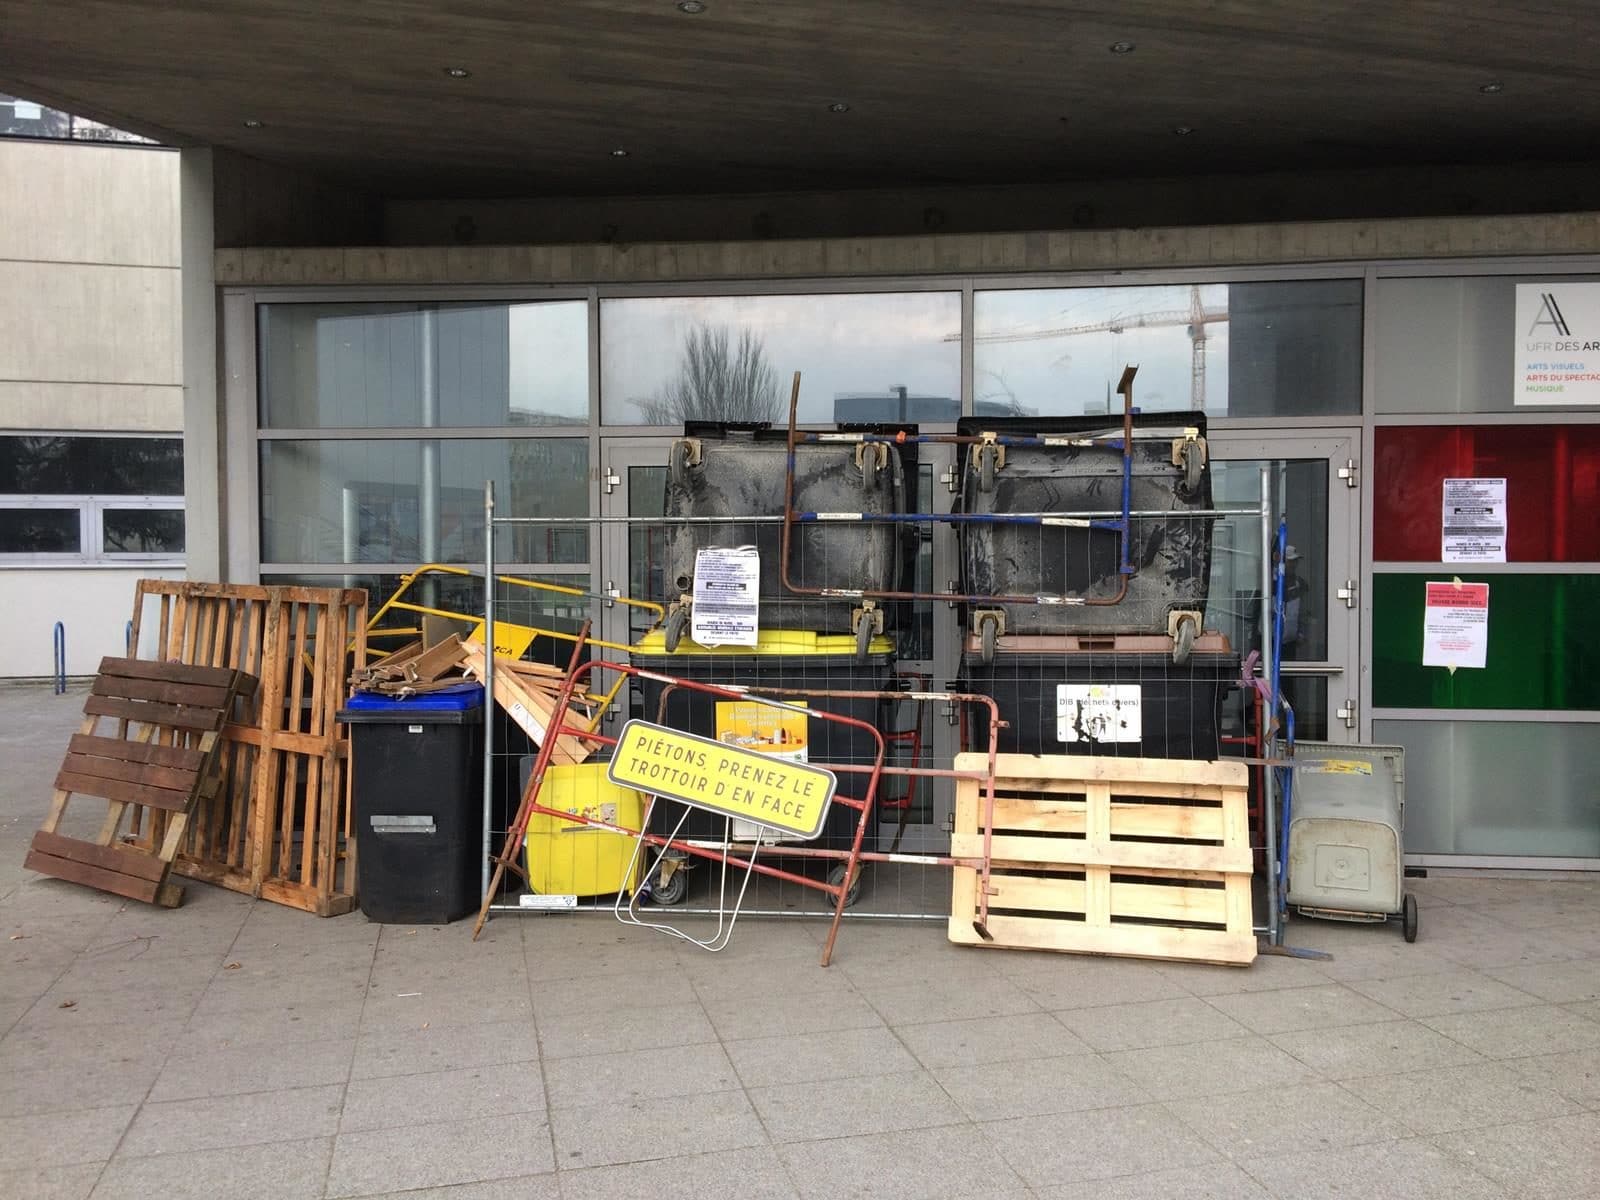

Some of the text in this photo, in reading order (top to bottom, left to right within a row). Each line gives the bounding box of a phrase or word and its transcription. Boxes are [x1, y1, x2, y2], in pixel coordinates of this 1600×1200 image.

[1526, 342, 1552, 352] UFR
[1555, 341, 1580, 352] DES
[1526, 374, 1548, 382] ARTS
[1550, 374, 1563, 382] DU
[630, 758, 708, 792] TROTTOIR
[761, 795, 805, 819] FACE
[719, 759, 786, 789] PRENEZ
[793, 779, 814, 797] LE
